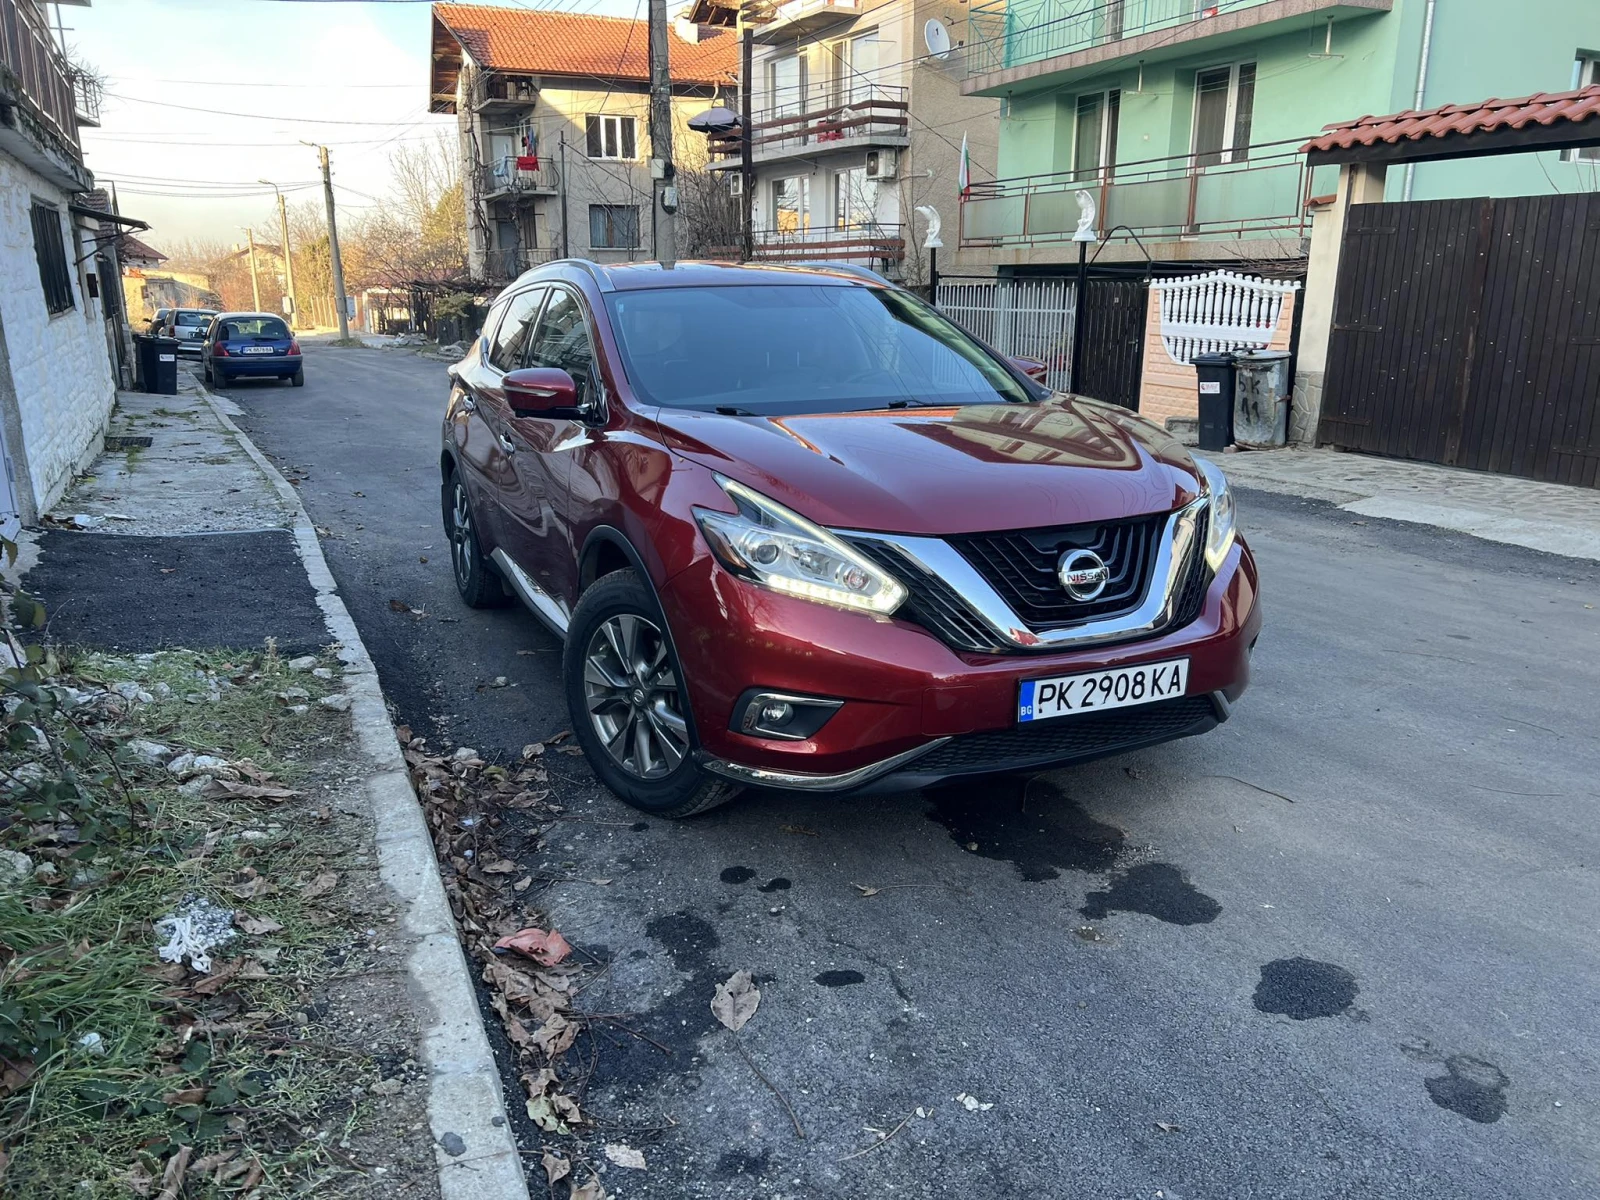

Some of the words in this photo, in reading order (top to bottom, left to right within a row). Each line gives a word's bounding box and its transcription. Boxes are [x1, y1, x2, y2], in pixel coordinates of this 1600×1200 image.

[1067, 567, 1107, 582] NISSAN
[1038, 680, 1075, 714] PK
[1080, 671, 1146, 708] 2908
[1150, 664, 1181, 697] KA
[1020, 705, 1033, 716] BG
